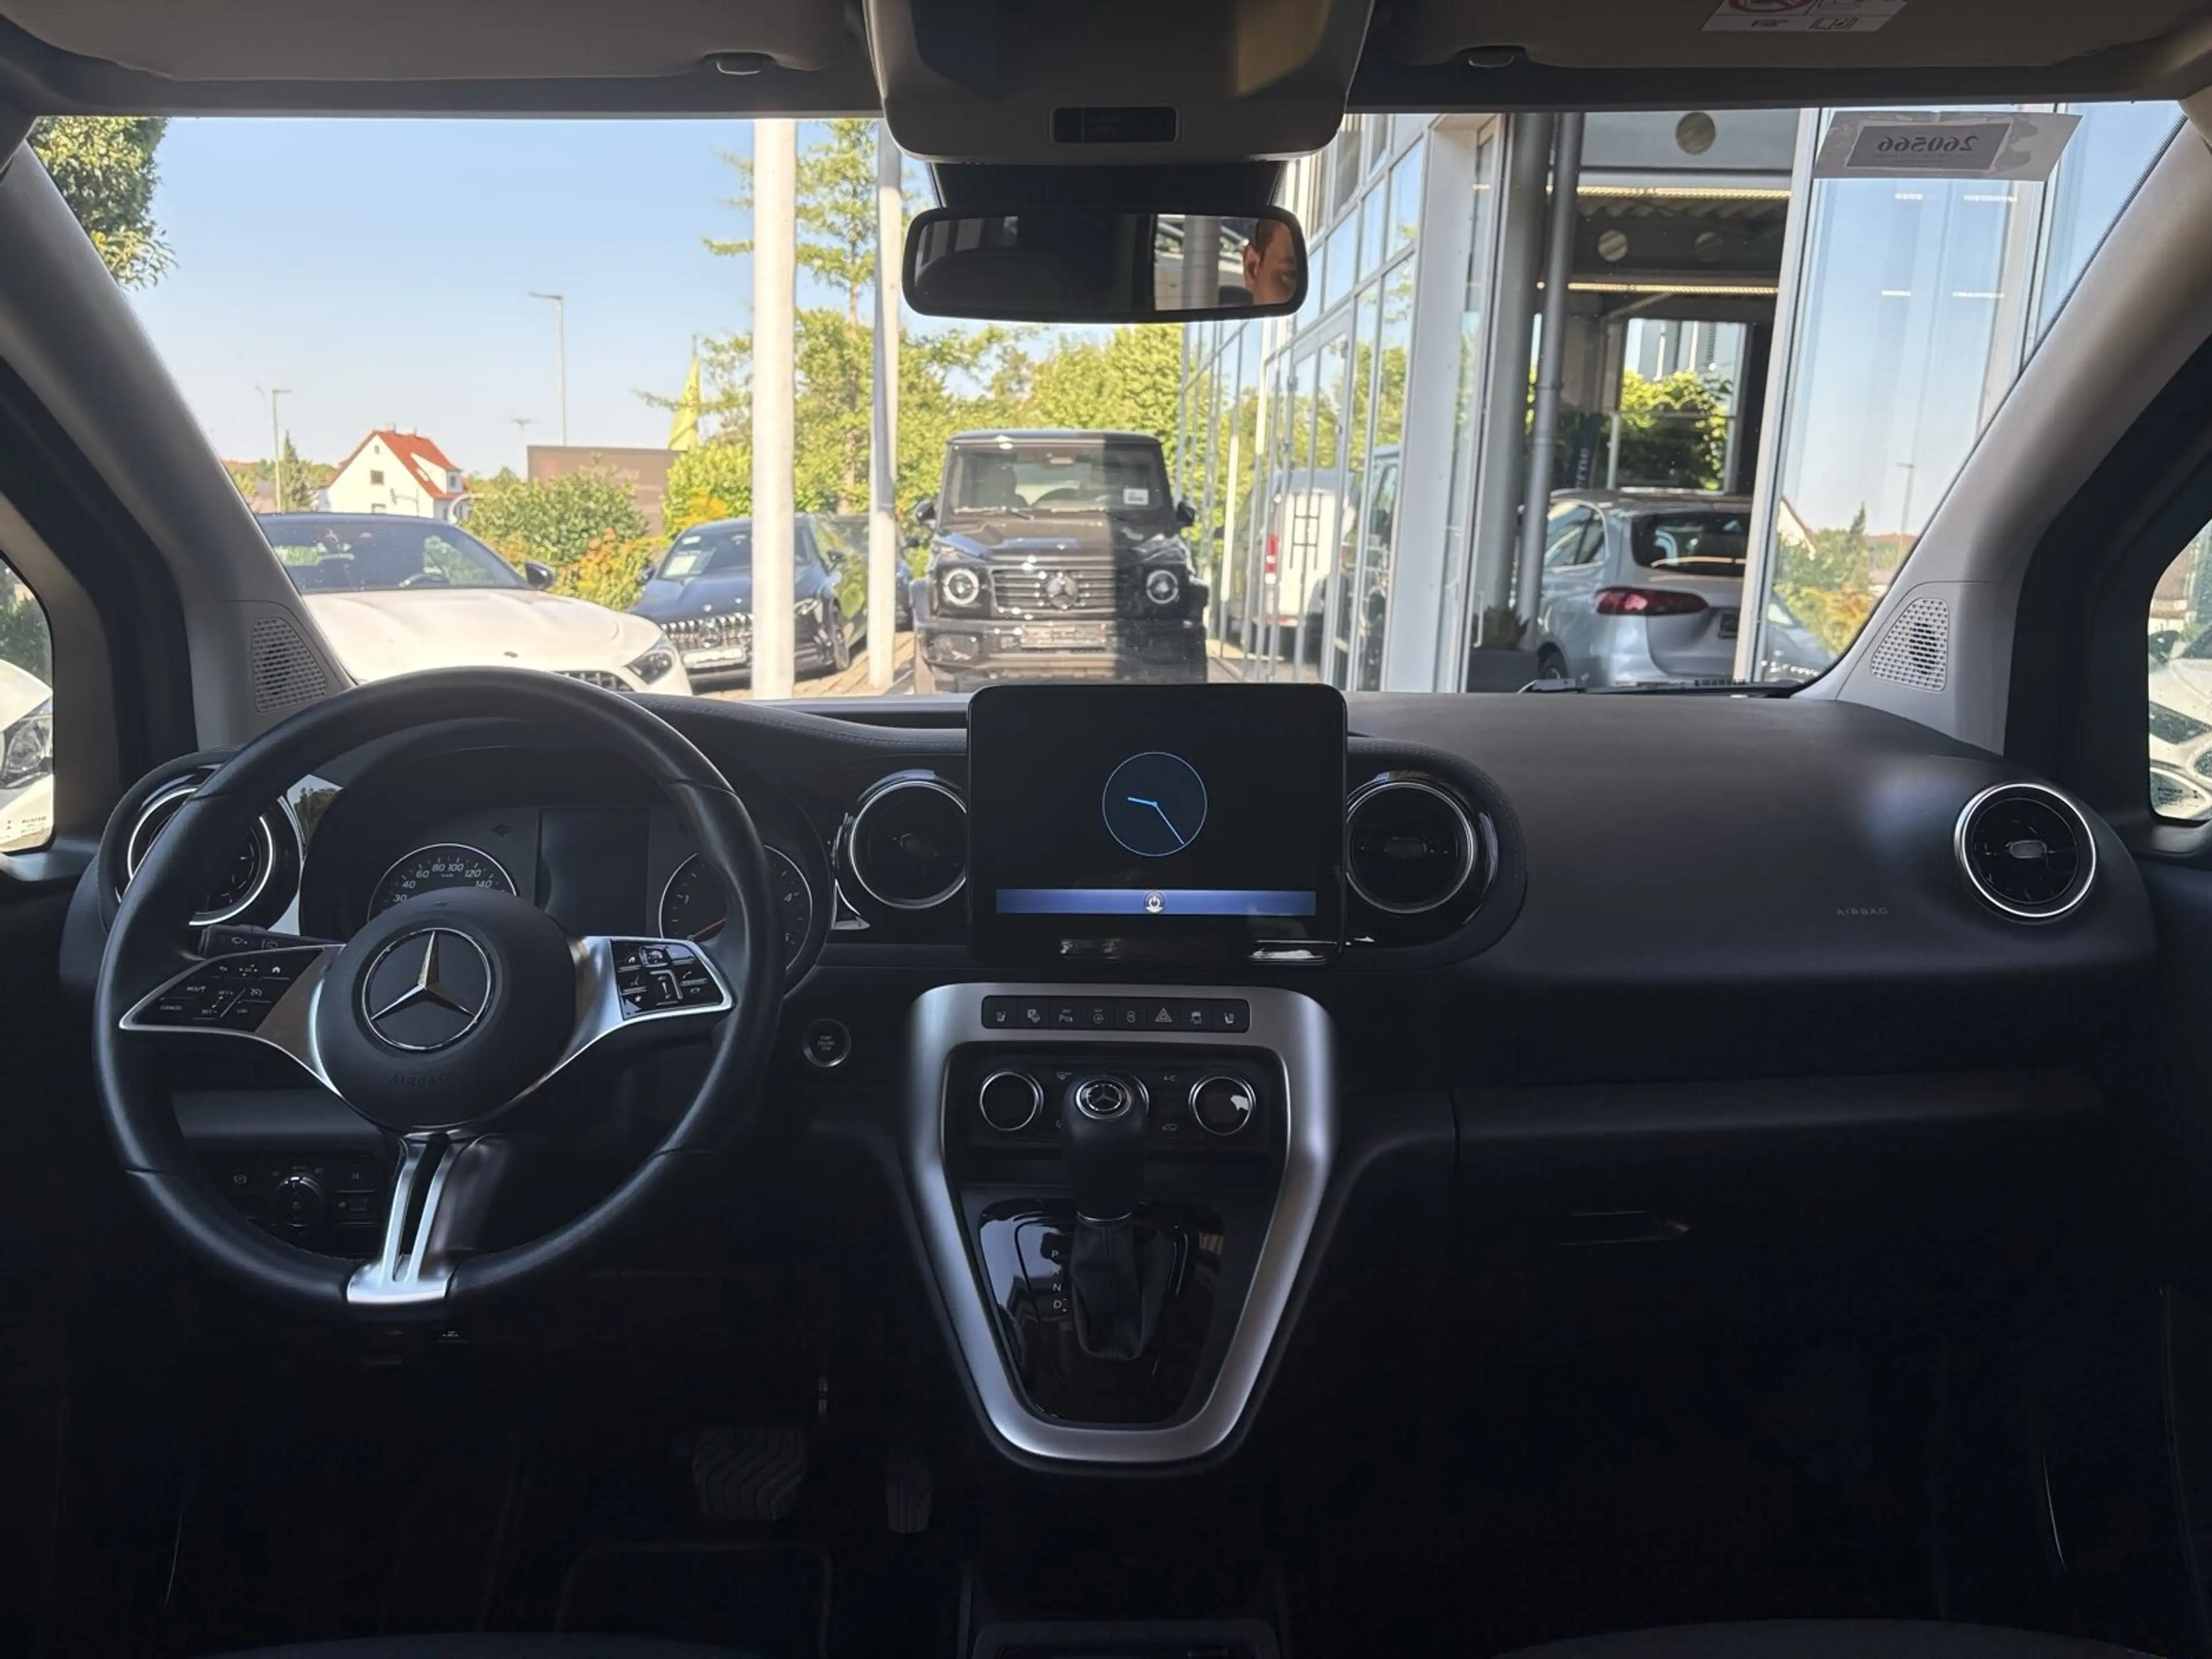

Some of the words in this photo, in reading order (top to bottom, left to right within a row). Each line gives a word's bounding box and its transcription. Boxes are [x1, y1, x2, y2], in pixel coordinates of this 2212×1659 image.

[431, 863, 446, 872] 80
[447, 863, 464, 872] 100
[415, 870, 430, 879] 60
[464, 869, 482, 878] 120
[402, 880, 416, 889] 40
[475, 879, 493, 888] 140
[392, 893, 408, 903] 30
[1836, 907, 1888, 916] AIRBAG
[1050, 1249, 1060, 1259] P
[1052, 1282, 1062, 1293] N
[1052, 1299, 1063, 1310] D
